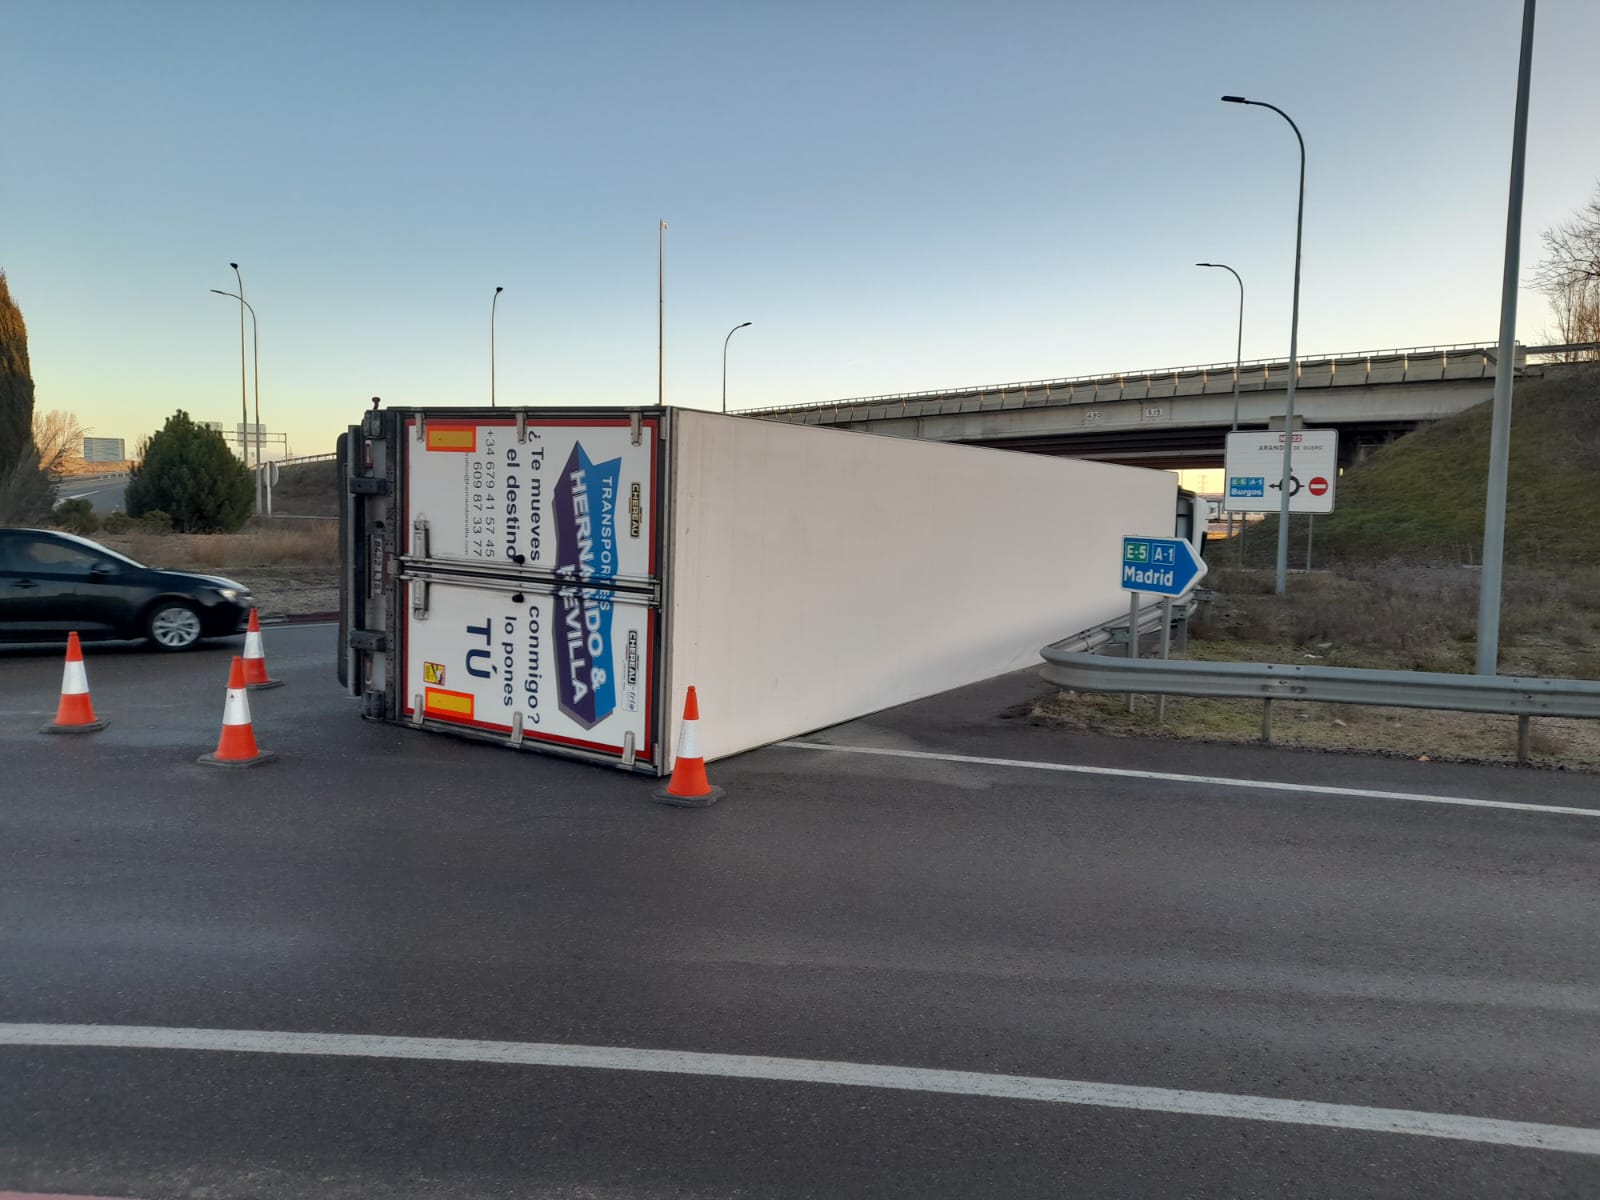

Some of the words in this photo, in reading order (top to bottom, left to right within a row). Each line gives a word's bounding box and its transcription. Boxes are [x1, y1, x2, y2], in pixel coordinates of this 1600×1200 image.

[485, 428, 495, 456] +34
[506, 448, 520, 468] el
[473, 461, 482, 489] 609
[485, 461, 495, 489] 679
[473, 493, 482, 512] 87
[485, 493, 495, 511] 41
[1231, 488, 1263, 497] Burgos
[506, 475, 520, 561] destino
[530, 478, 541, 561] mueves
[631, 483, 640, 537] CHEREAU
[473, 517, 482, 535] 33
[485, 516, 495, 534] 57
[473, 540, 482, 557] 77
[485, 539, 495, 558] 45
[1127, 545, 1147, 559] E-5
[1154, 547, 1175, 562] A-1
[1123, 565, 1174, 587] Madrid
[505, 616, 517, 635] lo
[466, 617, 498, 679] TÚ
[629, 631, 638, 684] CHEREAU
[502, 642, 514, 707] pones
[590, 667, 607, 691] &
